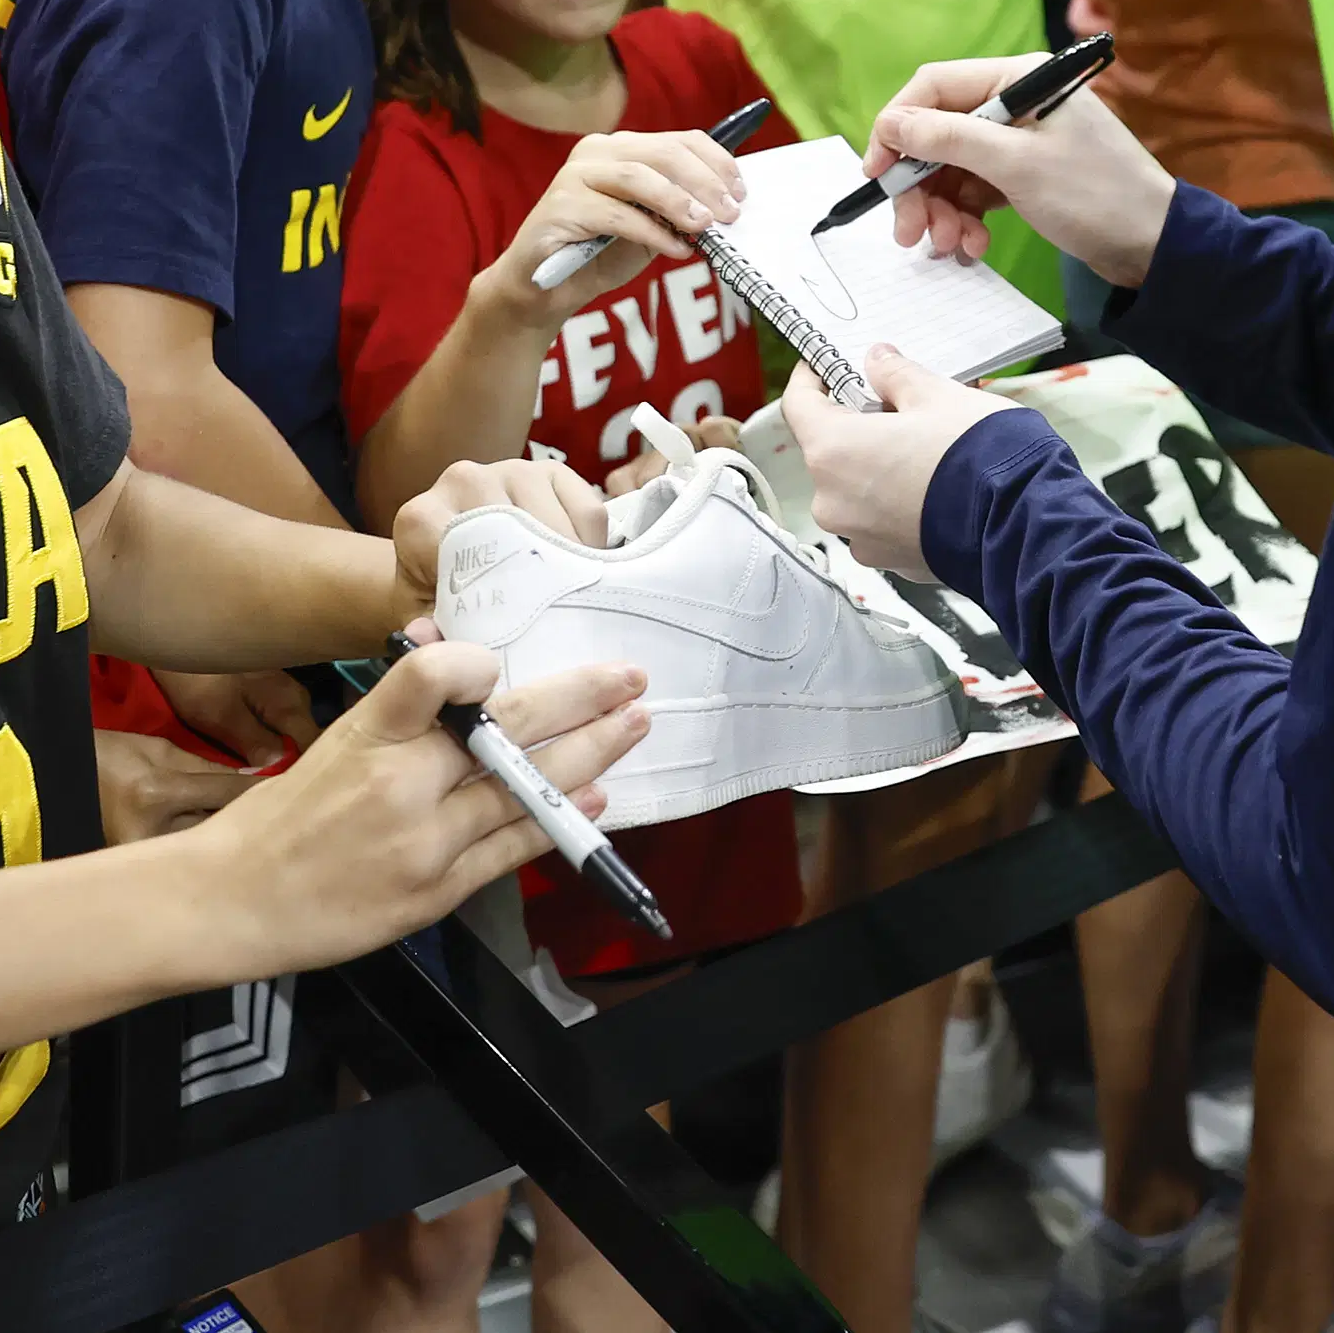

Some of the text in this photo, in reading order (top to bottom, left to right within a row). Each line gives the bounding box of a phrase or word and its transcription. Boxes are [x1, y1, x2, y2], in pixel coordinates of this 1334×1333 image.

[455, 540, 499, 572] NIKE
[454, 589, 505, 617] AIR
[188, 1305, 237, 1333] NOTICE
